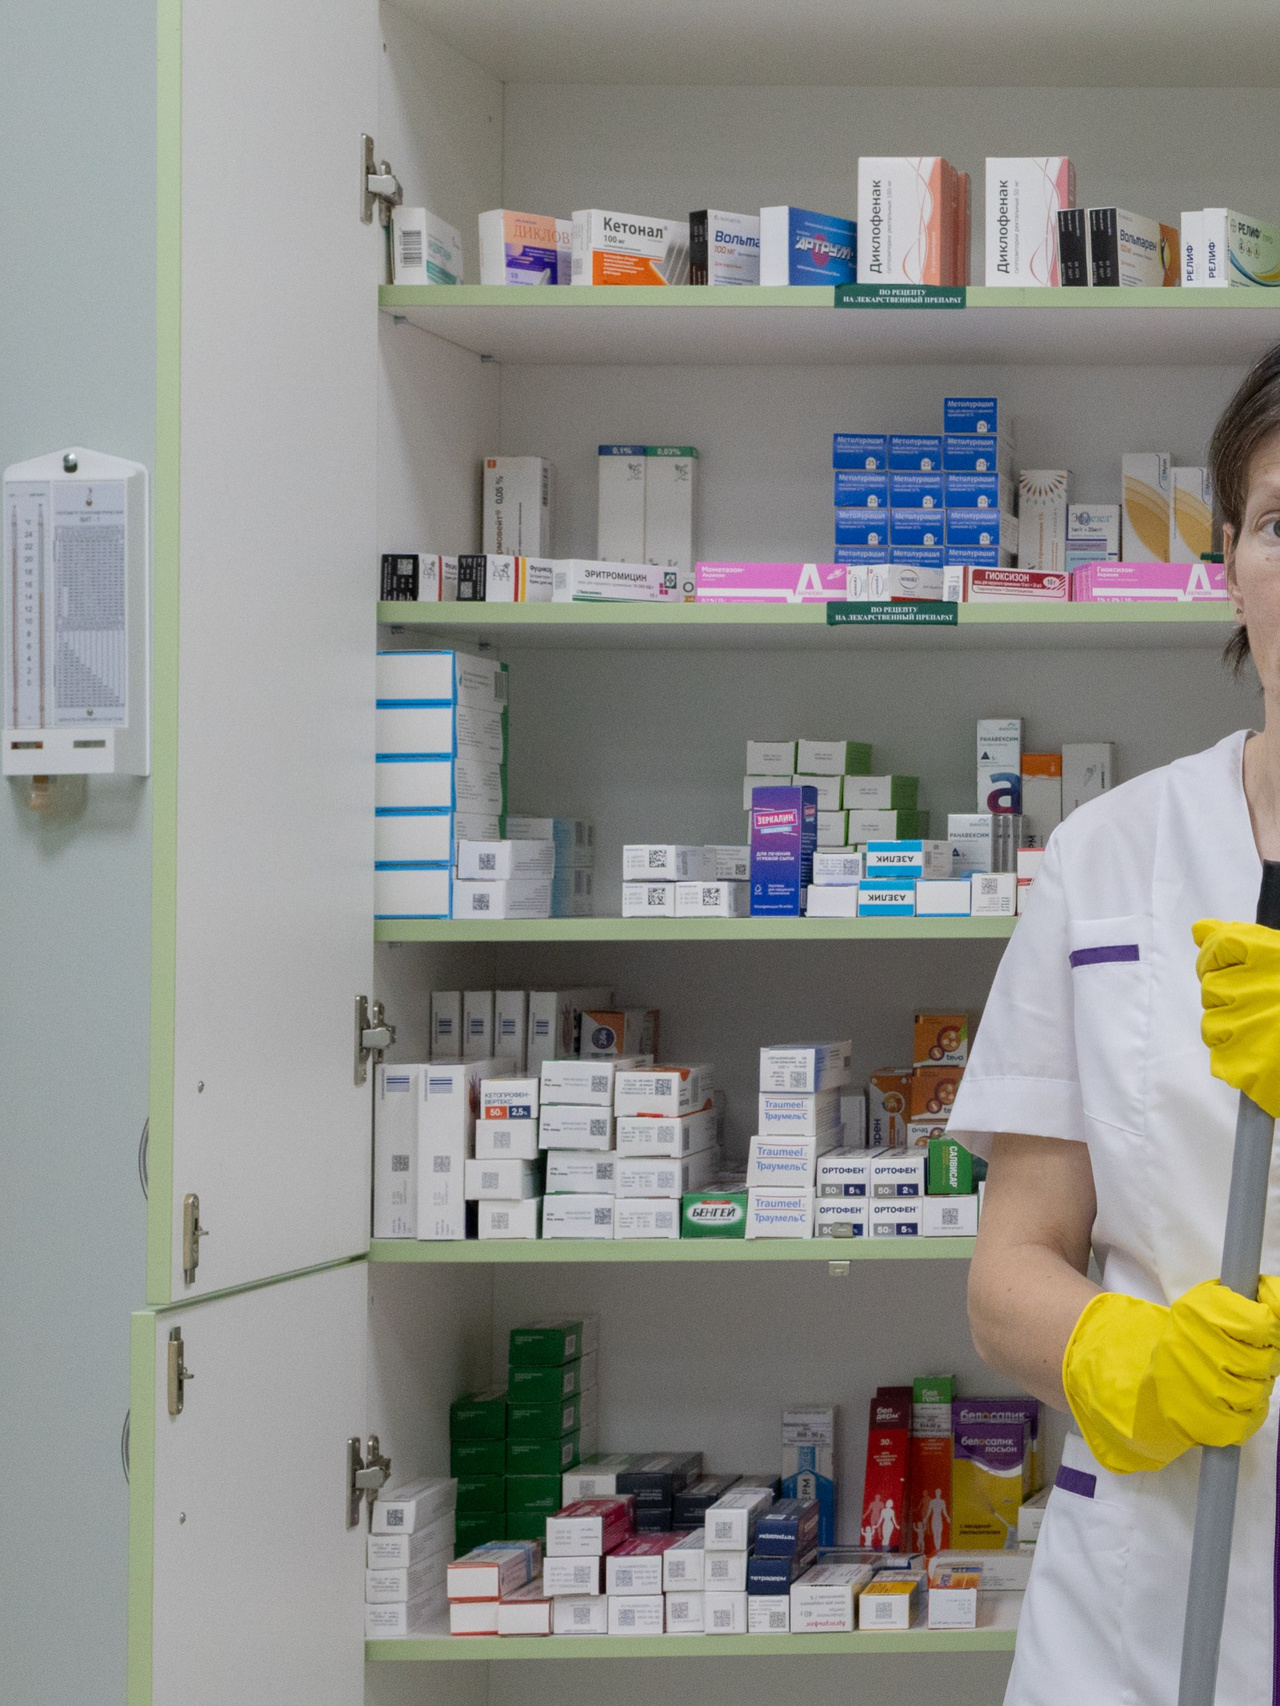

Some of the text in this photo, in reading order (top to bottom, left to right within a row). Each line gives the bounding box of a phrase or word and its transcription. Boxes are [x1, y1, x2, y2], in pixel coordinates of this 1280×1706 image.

[603, 217, 663, 238] Кетонал
[870, 179, 883, 274] Диклофенак
[997, 179, 1010, 274] Диклофенак
[1186, 244, 1194, 281] РЕЛИФ
[1208, 241, 1216, 278] РЕЛИФ
[856, 296, 923, 304] ЛЕКАРСТВЕННЫЙ
[947, 401, 994, 409] Метилурацил
[837, 437, 884, 445] Метилурацил
[892, 438, 938, 446] Метилурацил
[947, 438, 994, 446] Метилурацил
[839, 475, 885, 483] Метилурацил
[893, 475, 939, 483] Метилурацил
[949, 475, 995, 483] Метилурацил
[839, 512, 886, 521] Метилурацил
[895, 513, 941, 521] Метилурацил
[951, 512, 997, 521] Метилурацил
[839, 550, 885, 558] Метилурацил
[893, 550, 940, 558] Метилурацил
[949, 550, 995, 558] Метилурацил
[585, 570, 647, 582] ЭРИТРОМИЦИН
[985, 572, 1030, 582] ГИОКСИЗОН
[757, 814, 794, 824] ЗЕРКАЛИН
[765, 1100, 803, 1108] Traumeel
[757, 1147, 803, 1156] Traumeel
[755, 1199, 801, 1208] Traumeel
[691, 1208, 736, 1218] БЕНГЕЙ
[819, 1206, 862, 1214] ОРТОФЕН
[874, 1206, 916, 1214] ОРТОФЕН
[962, 1437, 1013, 1446] белосалик
